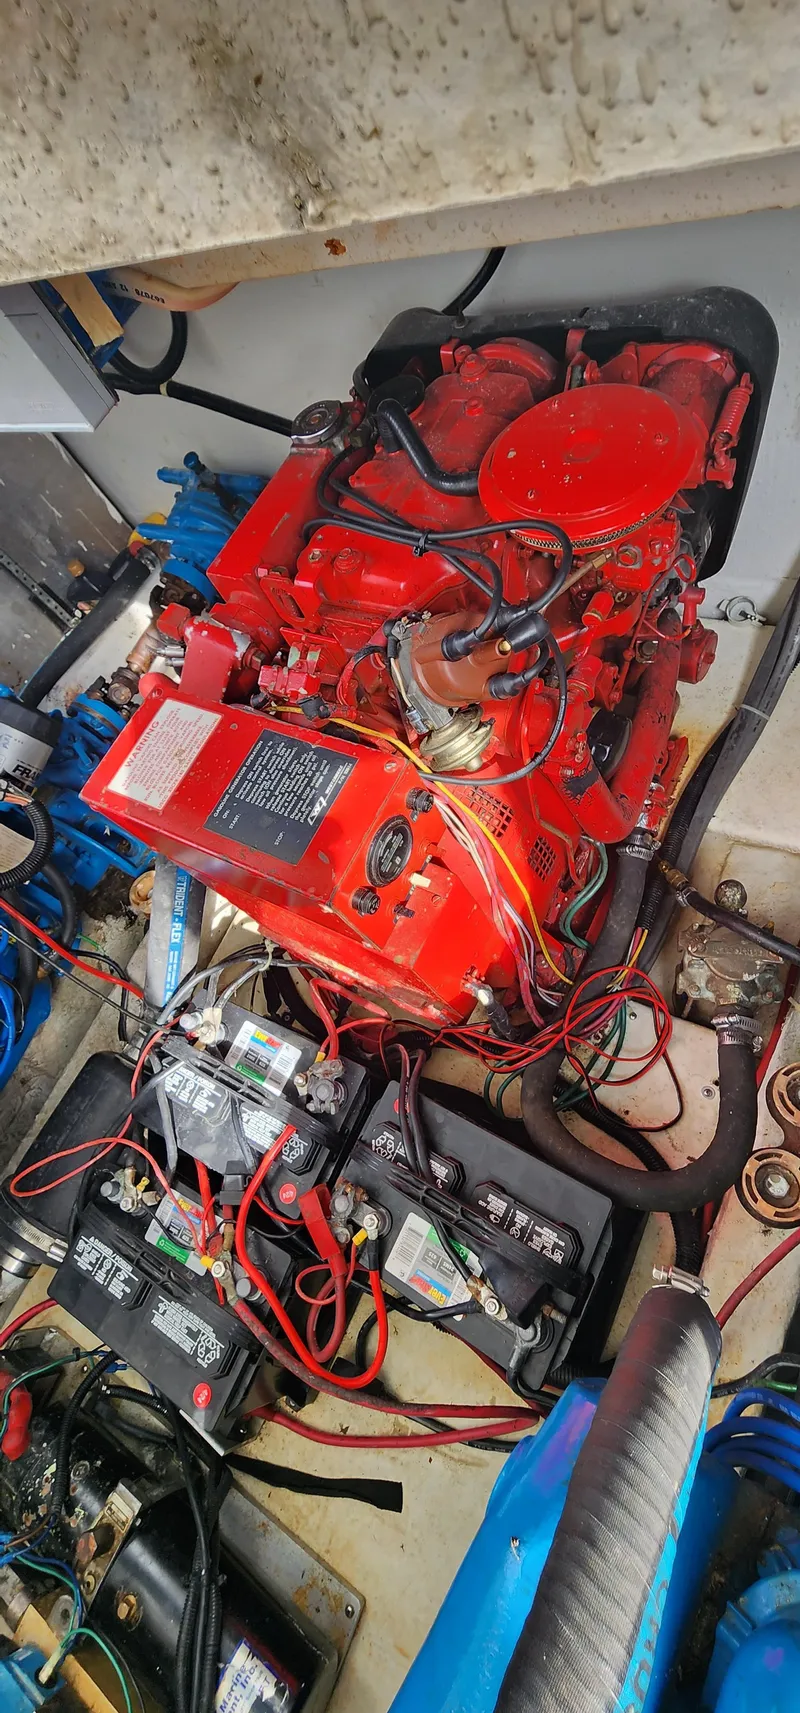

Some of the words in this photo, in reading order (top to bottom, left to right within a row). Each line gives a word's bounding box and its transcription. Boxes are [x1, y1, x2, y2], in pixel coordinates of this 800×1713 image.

[124, 719, 160, 767] WARNING
[212, 793, 230, 817] GASOLINE
[227, 766, 247, 793] GENERATOR
[244, 740, 264, 766] OPERATION
[234, 779, 249, 798] Depress
[246, 770, 254, 779] ON
[251, 756, 263, 770] switch
[260, 746, 269, 756] first
[238, 781, 253, 799] activate
[250, 765, 263, 781] control
[245, 783, 260, 802] Depress
[256, 769, 268, 783] START
[265, 754, 277, 769] switch
[274, 741, 285, 754] while
[249, 779, 267, 804] continuing
[267, 756, 282, 774] depress
[279, 747, 287, 755] ON
[253, 789, 266, 805] switch
[269, 769, 278, 779] also
[276, 748, 291, 769] overrides
[257, 798, 266, 807] low
[268, 770, 284, 790] pressure
[264, 795, 276, 809] When
[273, 773, 290, 795] generator
[268, 793, 282, 811] release
[279, 778, 292, 793] START
[288, 763, 301, 778] switch
[273, 792, 289, 813] Continue
[286, 774, 300, 792] holding
[296, 765, 305, 774] ON
[302, 750, 314, 765] switch
[277, 806, 286, 815] for
[286, 791, 295, 801] few
[291, 773, 306, 791] seconds
[303, 761, 313, 772] until
[289, 799, 304, 819] Depress
[300, 786, 312, 799] STOP
[308, 770, 321, 786] switch
[318, 759, 328, 770] until
[221, 808, 231, 819] ON:
[228, 812, 241, 829] START:
[282, 795, 298, 817] pressure
[295, 777, 309, 795] reaches
[293, 811, 302, 821] the
[299, 788, 317, 811] generator
[313, 775, 325, 788] stops
[273, 830, 285, 845] STOP:
[173, 879, 186, 917] TRIDENT
[170, 921, 182, 943] FLEX
[407, 1271, 447, 1306] EverStart
[219, 1665, 247, 1713] Marine
